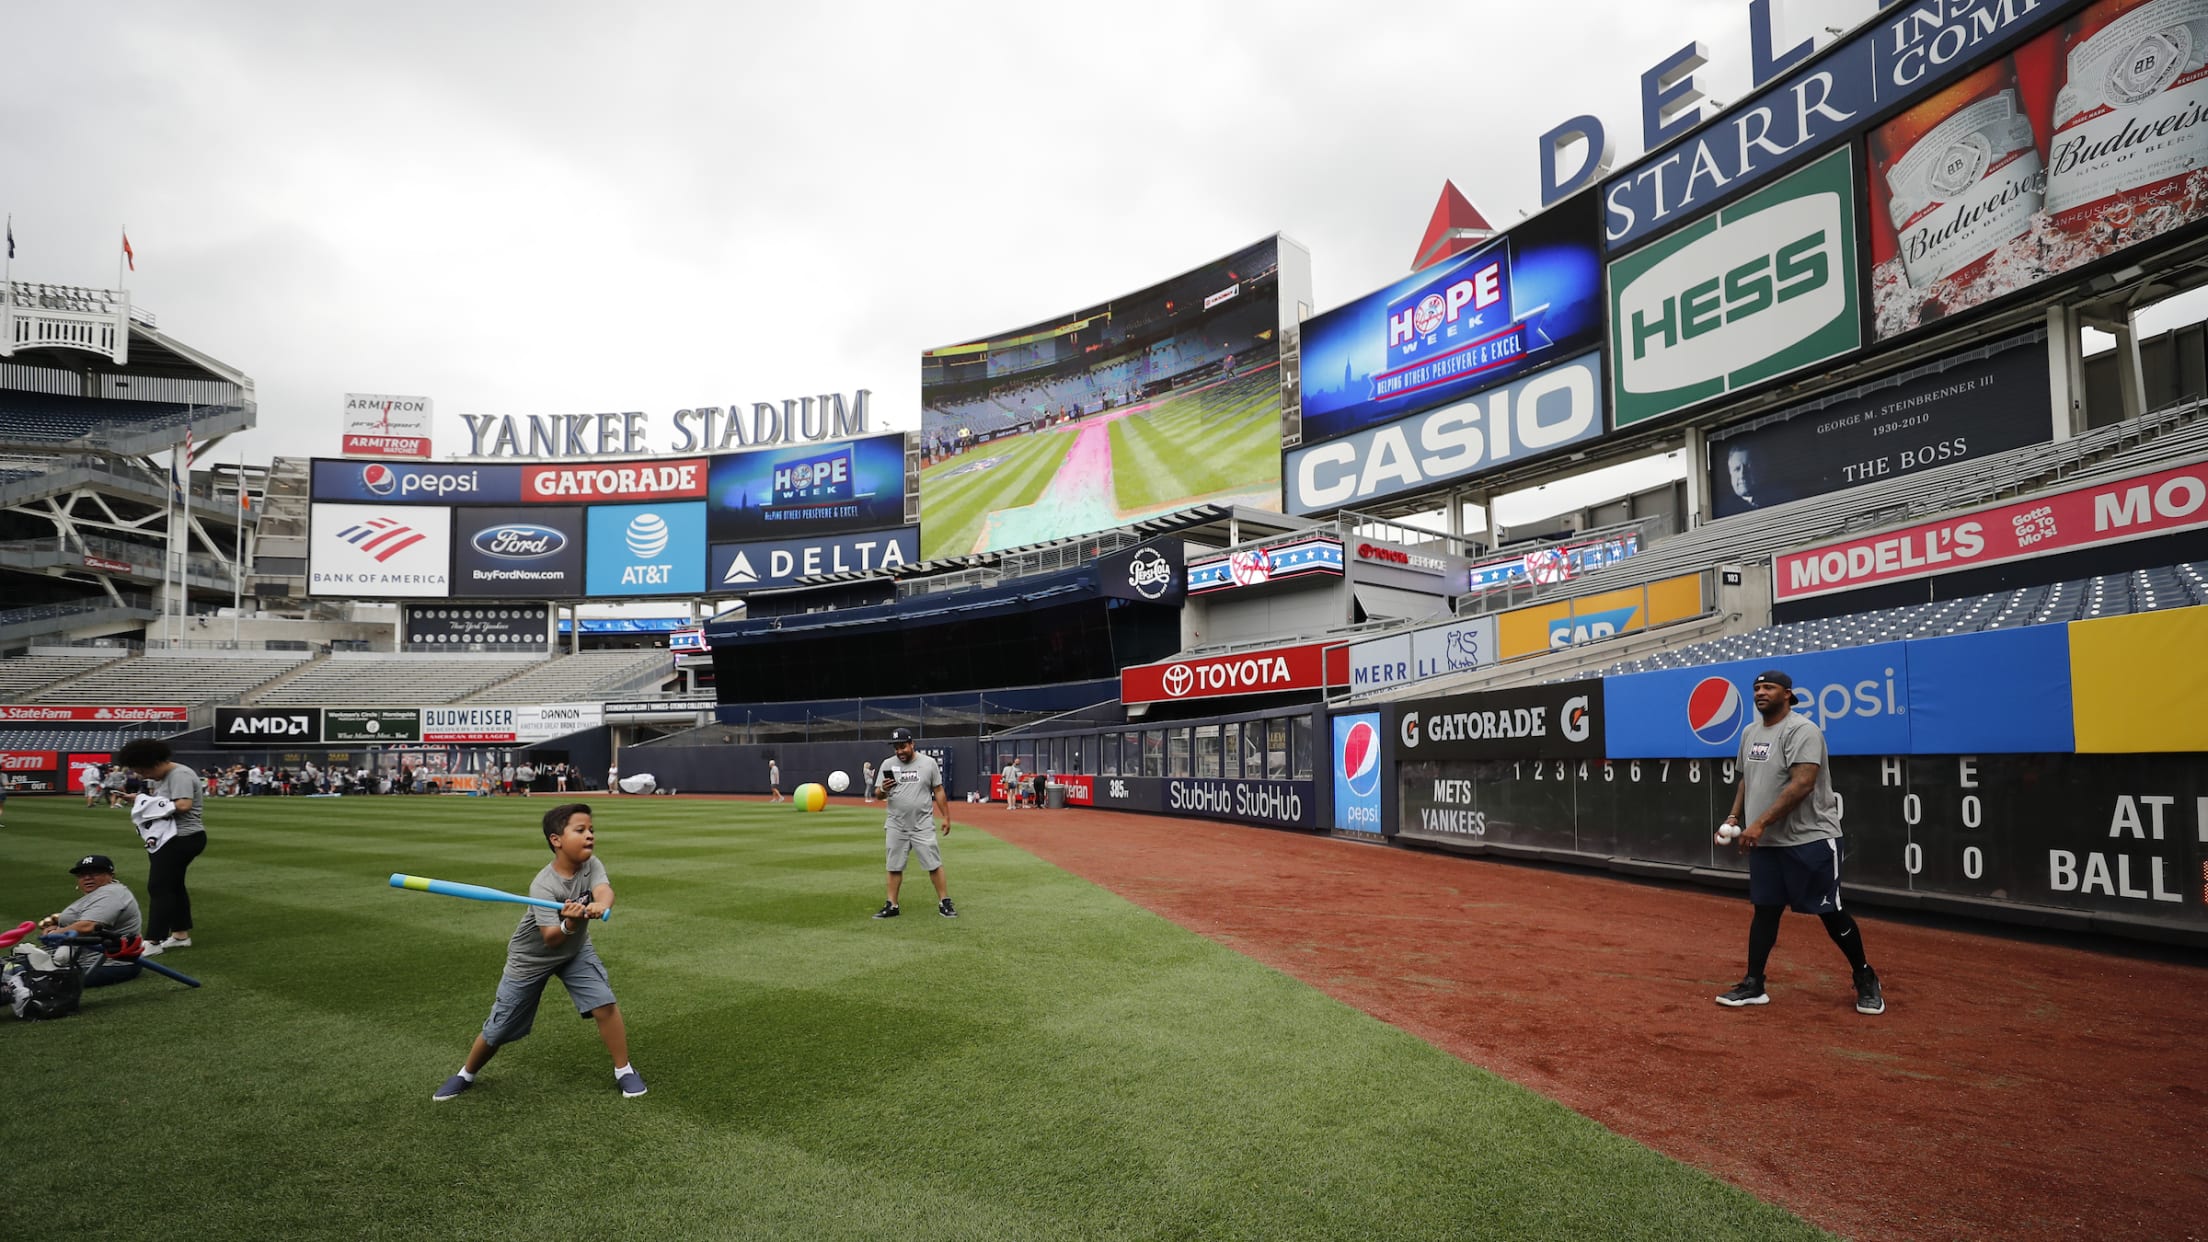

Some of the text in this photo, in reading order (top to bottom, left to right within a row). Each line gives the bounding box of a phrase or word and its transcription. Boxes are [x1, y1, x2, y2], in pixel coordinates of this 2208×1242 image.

[1540, 0, 1895, 208] DEL
[1606, 70, 1857, 241] STARR
[2075, 133, 2195, 176] KING OF BEERS
[1389, 261, 1502, 348] HOPE
[1631, 228, 1829, 361] HESS
[1402, 313, 1484, 355] WEEK
[1377, 334, 1522, 395] HELPING OTHERS PERSEVERE & EXCEL
[347, 399, 425, 412] ARMITRON
[1817, 374, 1995, 434] GEORGE M. STEINBRENNER III
[459, 388, 873, 458] YANKEE STADIUM
[1298, 363, 1595, 508] CASIO
[1872, 412, 1930, 437] 1930-2010
[349, 437, 420, 449] ARMITRON
[774, 457, 848, 491] HOPE
[1842, 437, 1967, 483] THE BOSS
[401, 470, 479, 497] pepsi
[533, 465, 698, 496] GATORADE
[782, 486, 837, 499] WEEK
[802, 506, 832, 519] PERSEVERE
[840, 505, 858, 518] EXCEL
[2012, 504, 2052, 527] Gotta
[2015, 515, 2055, 537] Go To
[491, 529, 548, 553] Ford
[2018, 526, 2057, 548] Mo's!
[770, 539, 905, 578] DELTA
[1374, 546, 1408, 564] TOYOTA
[1790, 521, 1985, 590] MODELL'S
[313, 572, 446, 585] BANK OF AMERICA
[472, 569, 565, 581] BuyFordNow.com
[621, 564, 672, 585] AT&T
[1196, 656, 1291, 690] TOYOTA
[1354, 657, 1440, 685] MERRLL
[229, 717, 288, 734] AMD
[426, 710, 512, 726] BUDWEISER
[541, 709, 580, 719] DANNON
[1428, 706, 1547, 741] GATORADE
[32, 782, 46, 790] OUT
[1513, 757, 1979, 788] 1 2 3 4 5 6 7 8 9 H E
[1170, 780, 1301, 822] StubHub StubHub
[1434, 779, 1472, 805] METS
[1347, 804, 1379, 825] pepsi
[1421, 807, 1486, 837] YANKEES
[1961, 795, 1982, 829] 0
[2108, 794, 2175, 840] AT
[1963, 846, 1984, 880] 0
[2049, 849, 2183, 903] BALL
